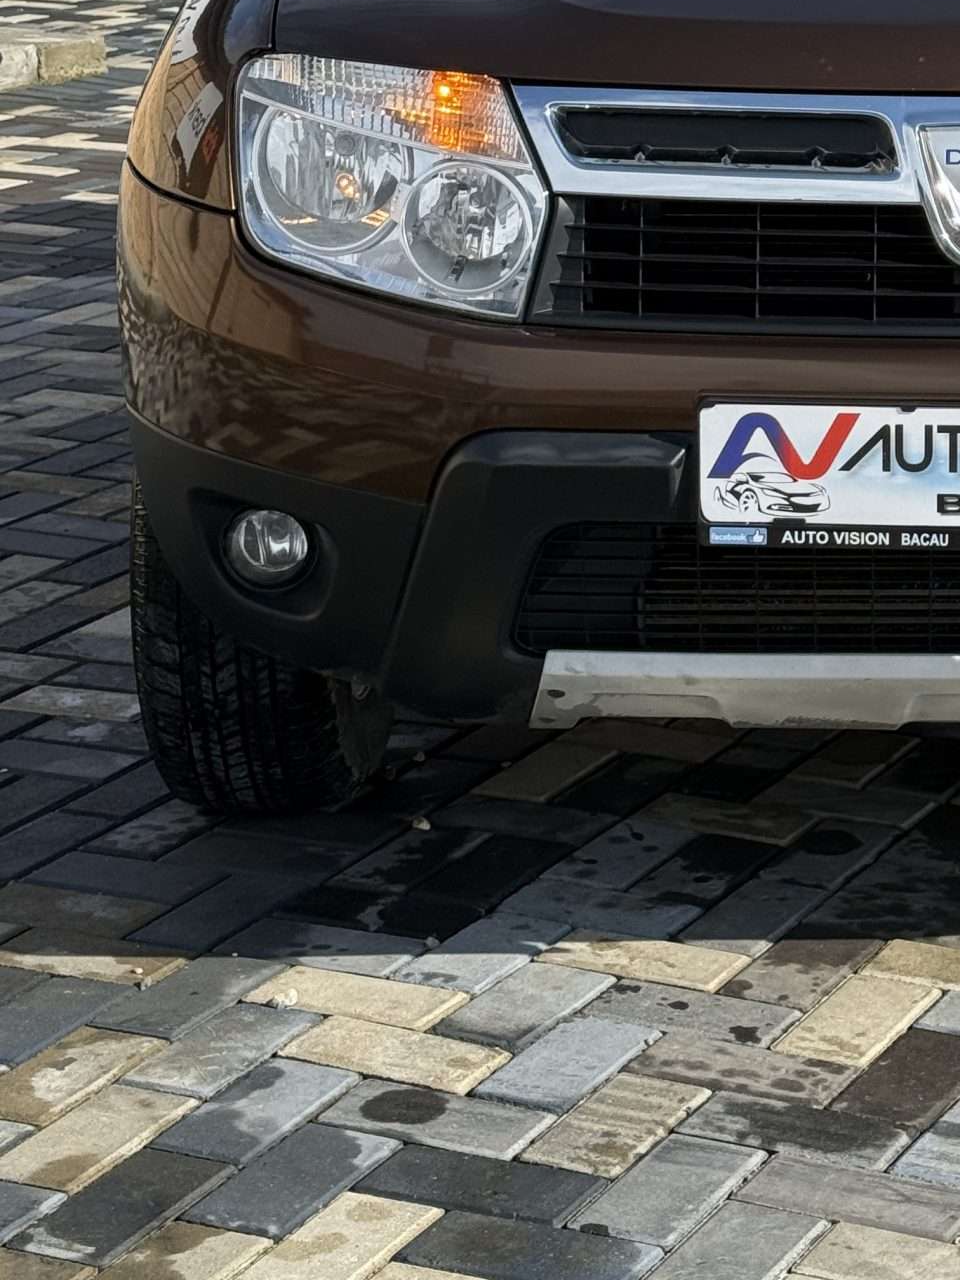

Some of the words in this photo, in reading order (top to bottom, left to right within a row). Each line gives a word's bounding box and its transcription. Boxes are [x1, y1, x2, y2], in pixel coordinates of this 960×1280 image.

[781, 531, 829, 545] AUTO
[833, 532, 890, 545] VISION
[901, 533, 949, 546] BACAU
